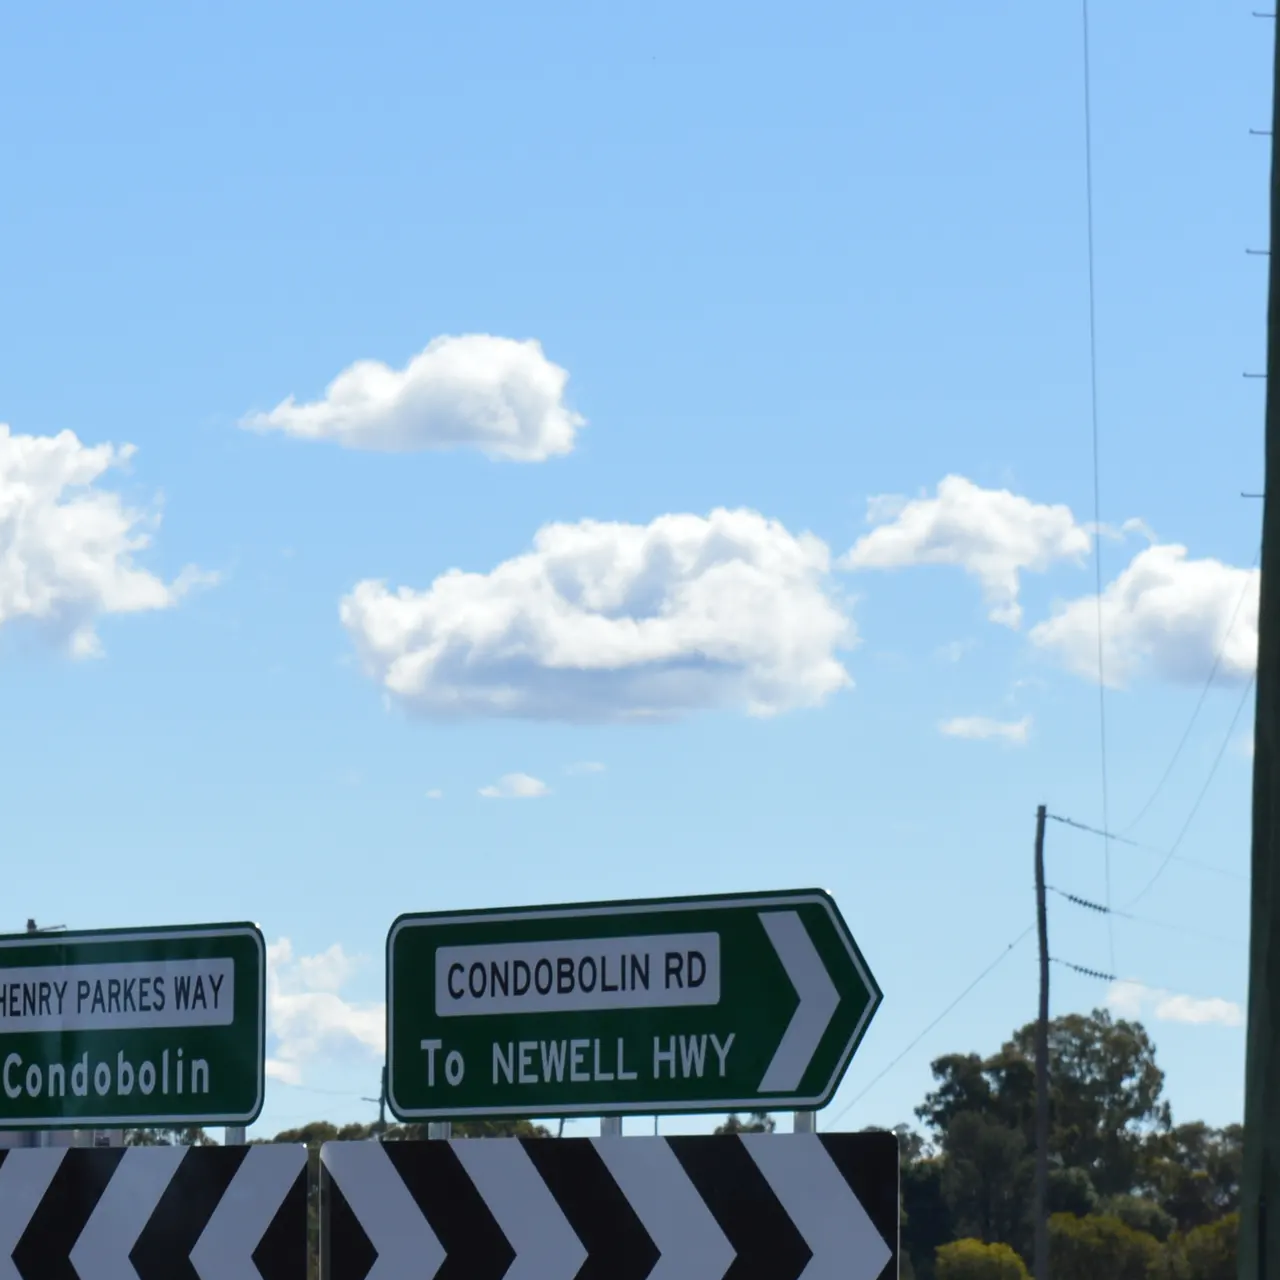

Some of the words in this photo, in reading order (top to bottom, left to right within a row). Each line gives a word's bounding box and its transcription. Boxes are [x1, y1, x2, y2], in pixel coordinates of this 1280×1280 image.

[77, 975, 165, 1014] PARKES
[174, 973, 224, 1011] WAY
[447, 953, 651, 1000] CONDOBOLIN
[664, 951, 707, 989] RD
[2, 1048, 210, 1099] Condobolin
[420, 1038, 465, 1087] To
[492, 1037, 638, 1086] NEWELL
[652, 1033, 736, 1079] HWY
